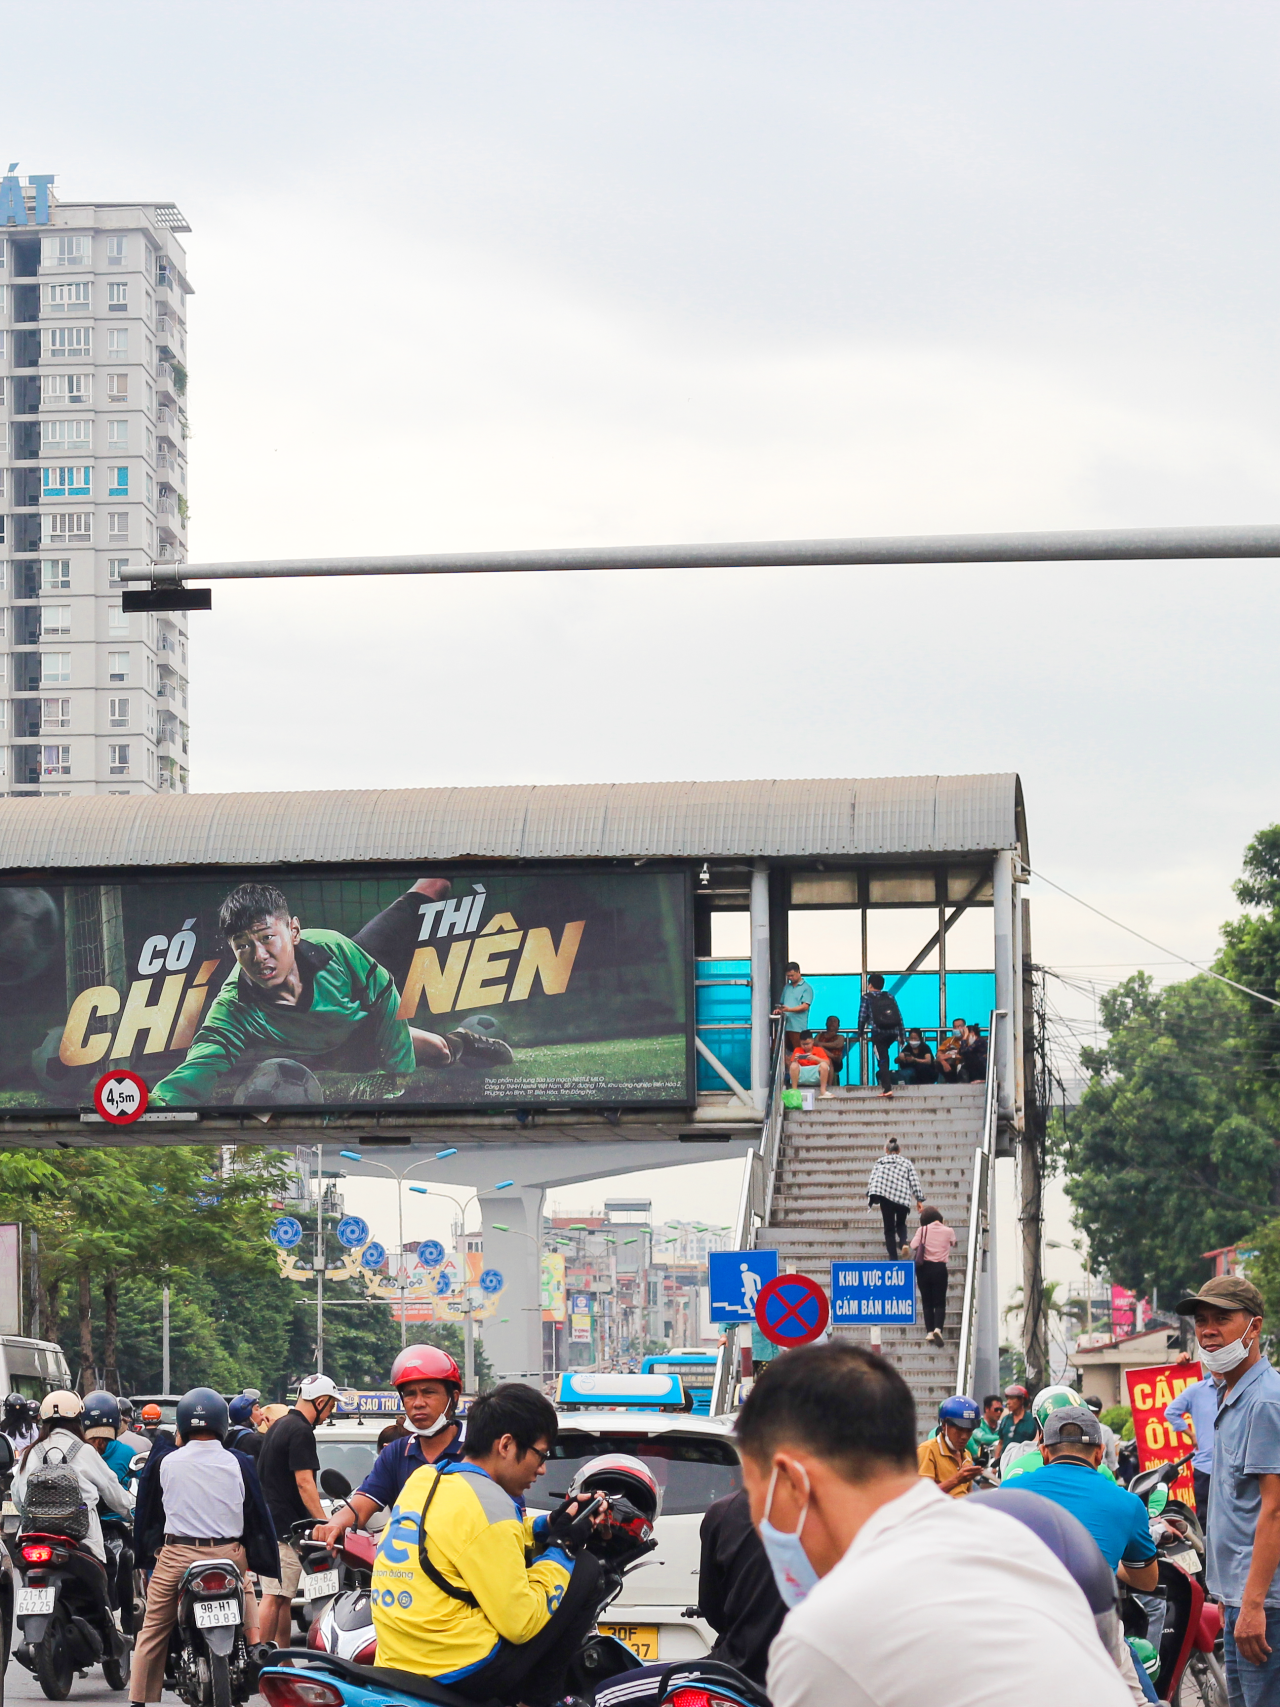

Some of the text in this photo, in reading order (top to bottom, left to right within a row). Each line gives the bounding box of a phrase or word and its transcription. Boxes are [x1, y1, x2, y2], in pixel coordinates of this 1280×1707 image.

[418, 884, 486, 941] THÌ
[137, 918, 197, 975] CÓ
[395, 912, 586, 1020] NÊN
[59, 959, 221, 1066] CHÍ
[107, 1088, 134, 1109] 4,5m
[838, 1271, 859, 1286] KHU
[862, 1269, 882, 1289] VỰC
[836, 1295, 912, 1315] CẤM BÁN HÀNG
[360, 1398, 379, 1411] SAO
[309, 1571, 333, 1587] 29-B2
[23, 1589, 48, 1601] 21-K1
[307, 1582, 337, 1598] 110.16
[18, 1601, 52, 1613] 642.25
[200, 1600, 232, 1615] 98-H1
[199, 1612, 237, 1627] 219.83
